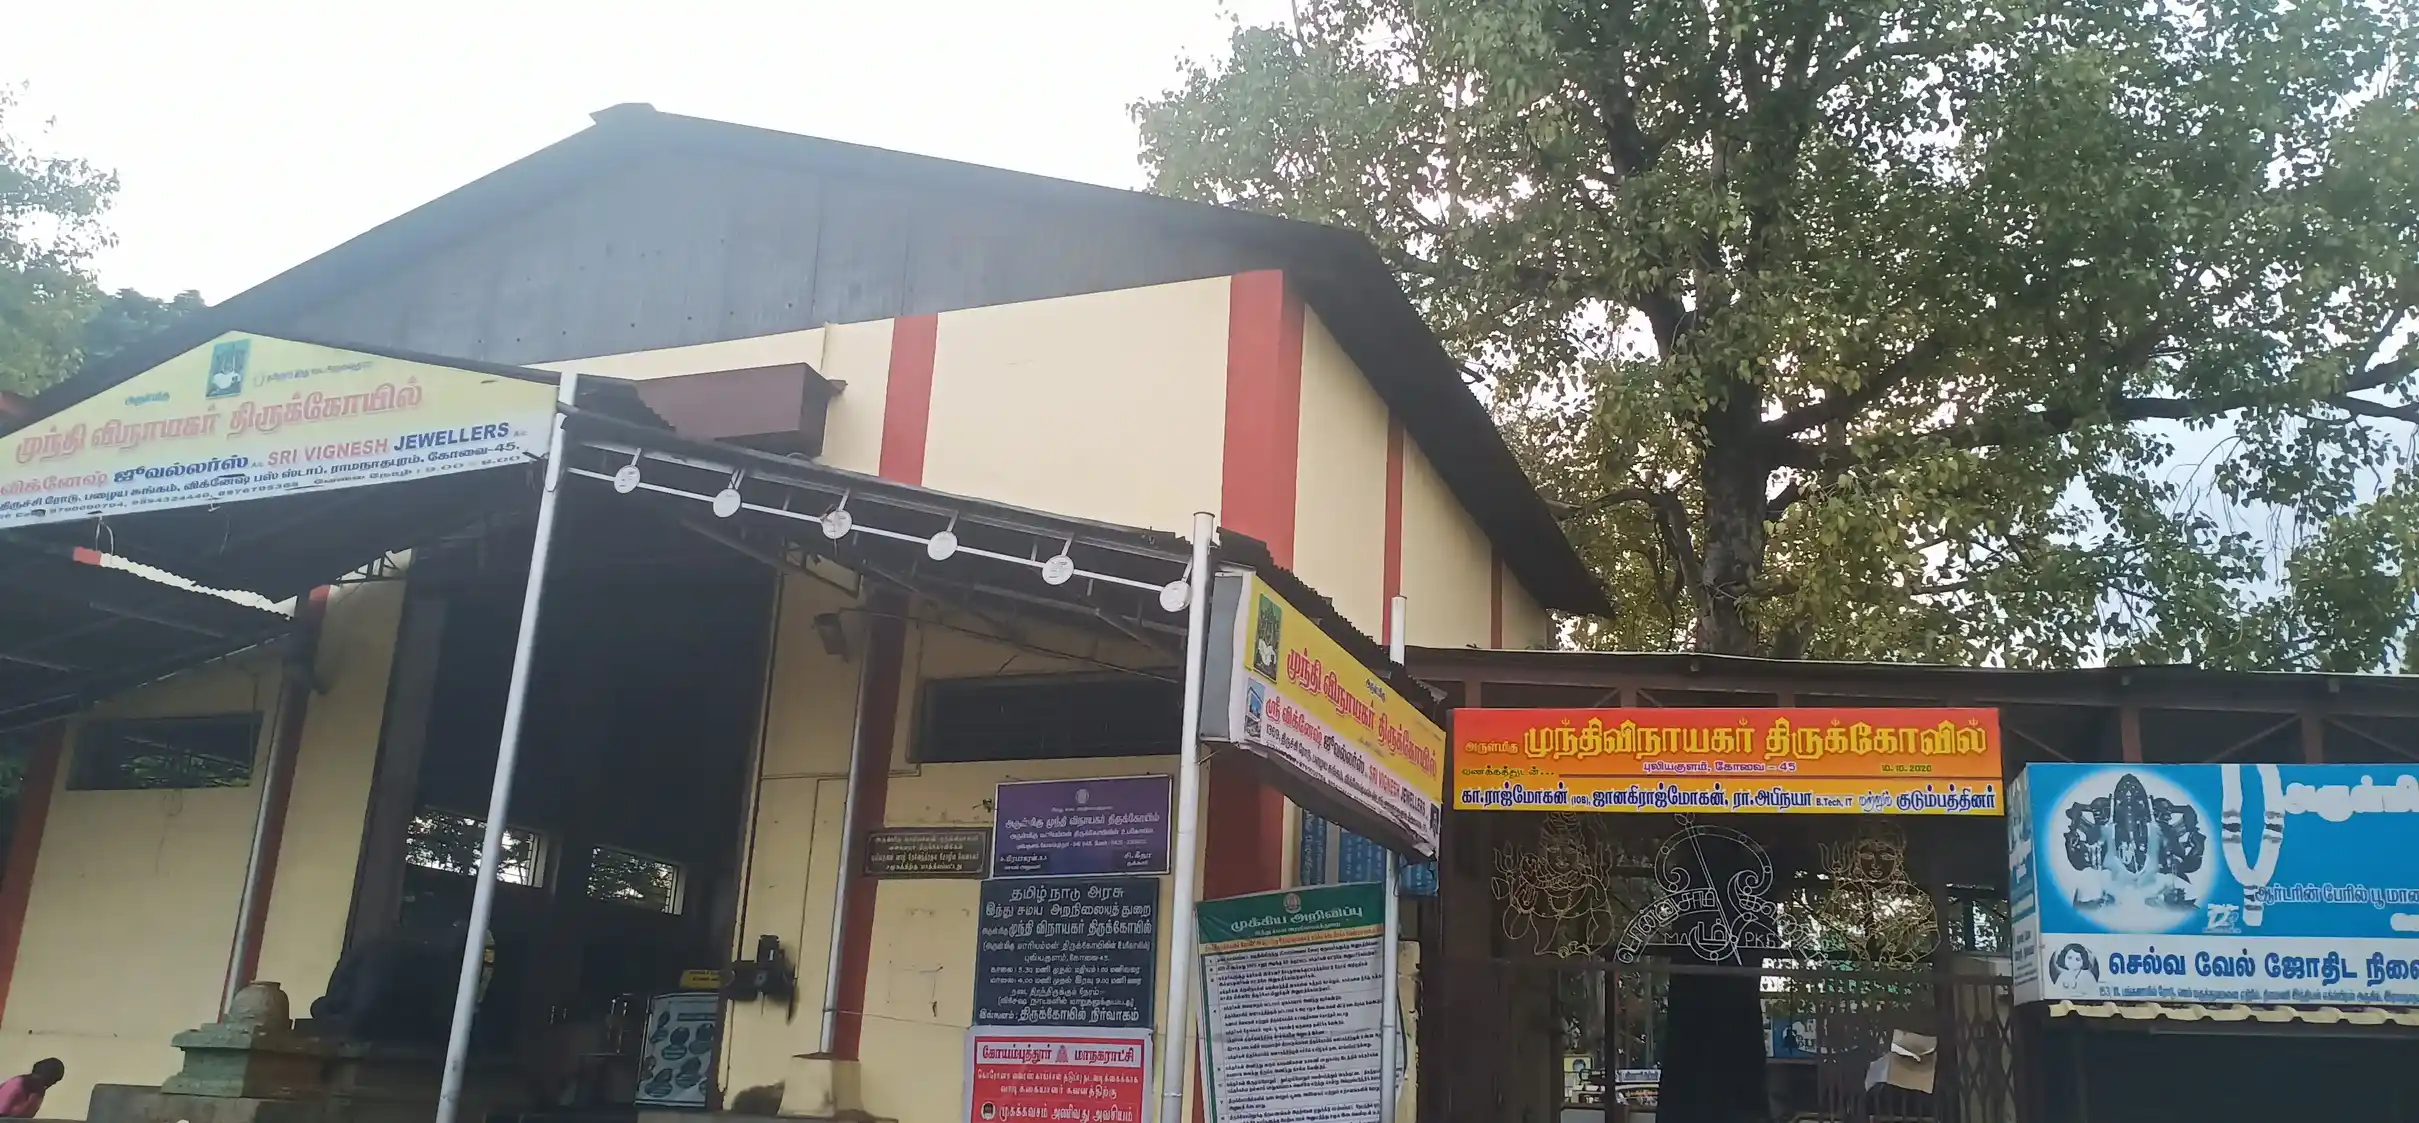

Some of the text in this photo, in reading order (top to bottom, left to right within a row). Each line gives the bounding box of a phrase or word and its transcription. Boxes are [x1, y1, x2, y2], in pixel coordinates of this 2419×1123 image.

[16, 376, 422, 463] முந்தி விநாயகர் திருக்கோயில்
[113, 455, 249, 484] ஜூவல்லர்ஸ்
[267, 449, 297, 467] SRI
[304, 438, 388, 462] VIGNESH
[394, 422, 509, 452] JEWELLERS
[1287, 648, 1321, 695] முந்தி
[1323, 671, 1375, 730] விநாயகர்
[1378, 713, 1437, 777] திருக்கோயில்
[1282, 706, 1322, 749] விக்னேஷ்
[1324, 735, 1365, 774] ஜூவல்லர்ஸ்
[1523, 717, 1755, 759] முந்திவிநாயகர்
[1764, 716, 1987, 760] திருக்கோவில்
[1643, 761, 1710, 774] புலியகுளம்,
[1714, 761, 1764, 772] கோவை
[1779, 762, 1796, 771] 45
[1733, 786, 1812, 810] ரா.அபிநயா
[1845, 798, 1852, 806] IT
[1896, 784, 1995, 811] குடும்பத்தினர்
[1046, 816, 1067, 829] முந்தி
[1069, 814, 1106, 827] விநாயகர்
[1087, 886, 1124, 900] அரசு
[2255, 883, 2322, 904] ஆர்டரின்
[2323, 883, 2369, 903] பேரில்
[2371, 887, 2386, 909] பூ
[985, 901, 1014, 918] இந்து
[1017, 905, 1044, 916] சமய
[1230, 905, 1363, 932] முக்கிய அறிவிப்பு
[1008, 919, 1034, 937] முந்தி
[1036, 918, 1085, 937] விநாயகர்
[1087, 919, 1152, 937] திருக்கோயில்
[1035, 965, 1051, 973] மணி
[1053, 965, 1073, 975] முதல்
[2108, 946, 2186, 976] செல்வ
[2194, 948, 2256, 977] வேல்
[2264, 951, 2357, 987] ஜோதிட
[1035, 976, 1052, 984] மணி
[1053, 976, 1073, 986] முதல்
[1018, 1005, 1087, 1023] திருக்கோயில்
[1089, 1006, 1140, 1023] நிர்வாகம்
[982, 1043, 1134, 1064] கோயம்புத்தூர் மாநகராட்சி
[1000, 1103, 1133, 1123] முகக்கவசம் அணிவது அவசியம்
